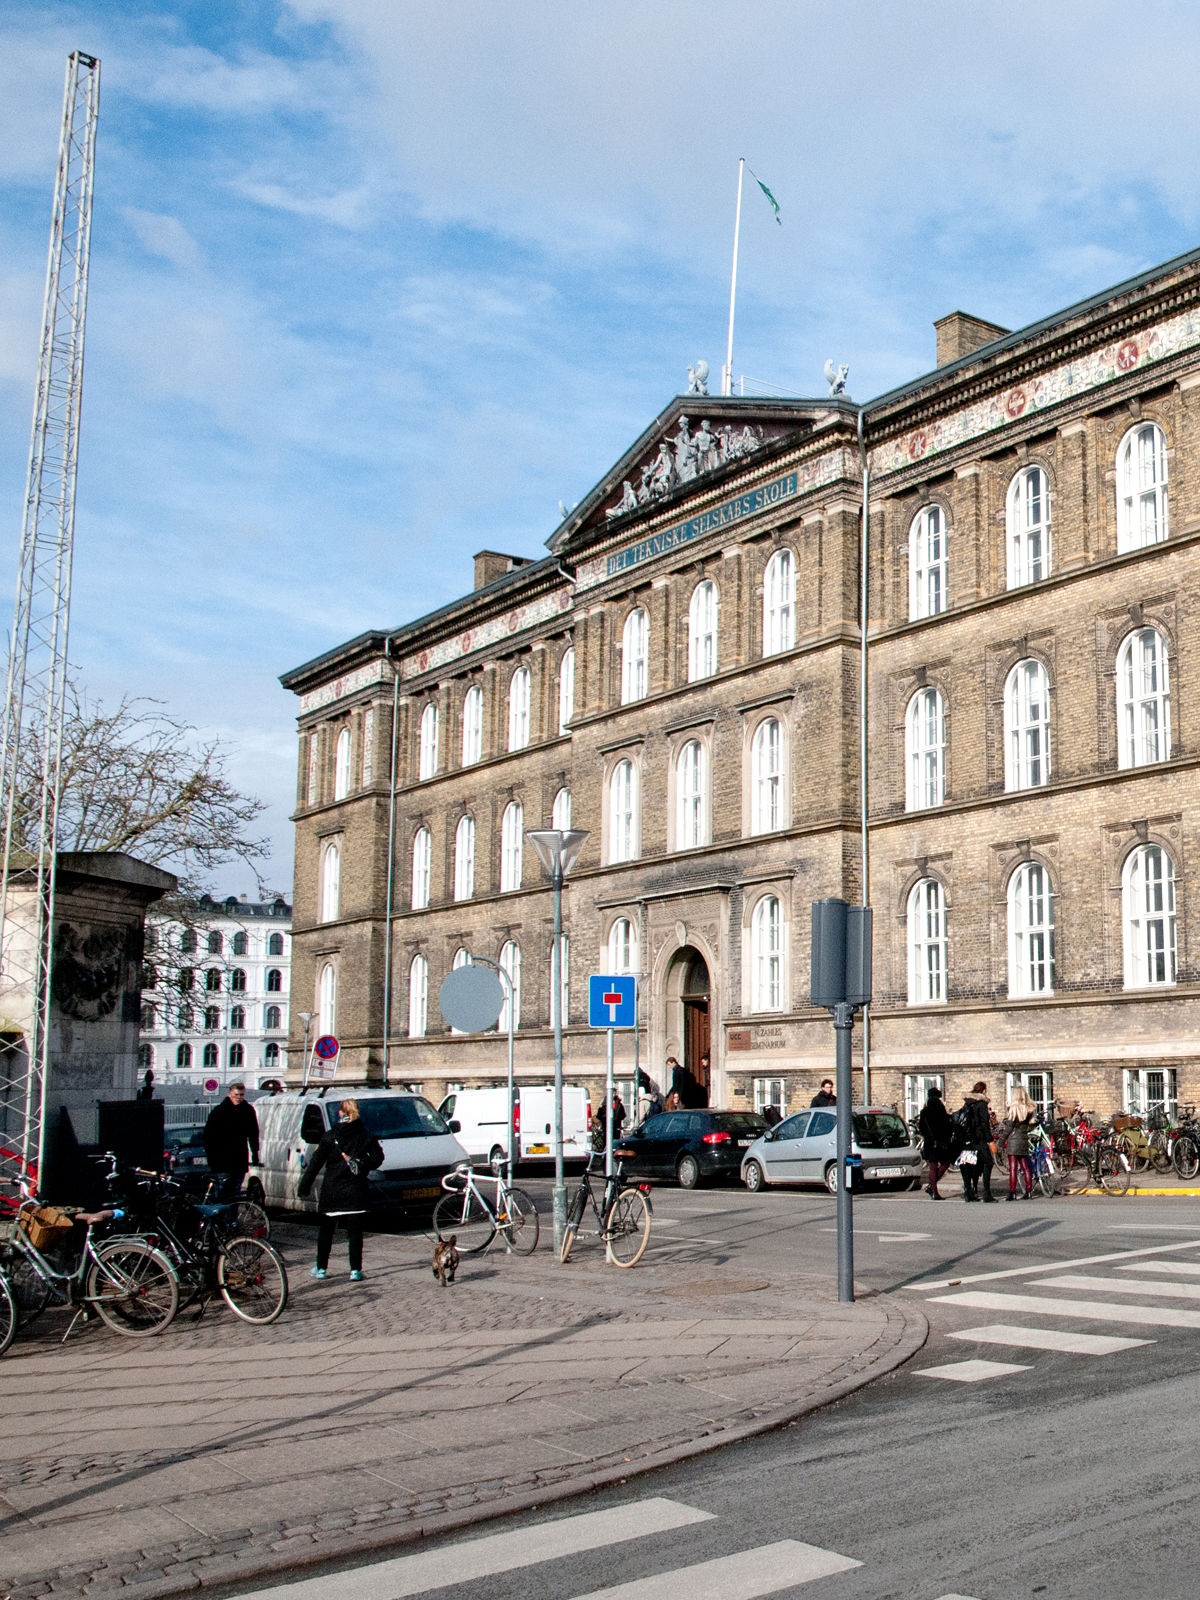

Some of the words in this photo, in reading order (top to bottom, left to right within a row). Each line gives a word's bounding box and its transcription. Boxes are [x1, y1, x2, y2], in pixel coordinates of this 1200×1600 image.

[609, 551, 628, 574] DET
[632, 525, 687, 562] TEKNISKE
[691, 497, 750, 537] SELSKABS
[755, 476, 795, 509] SKOLE
